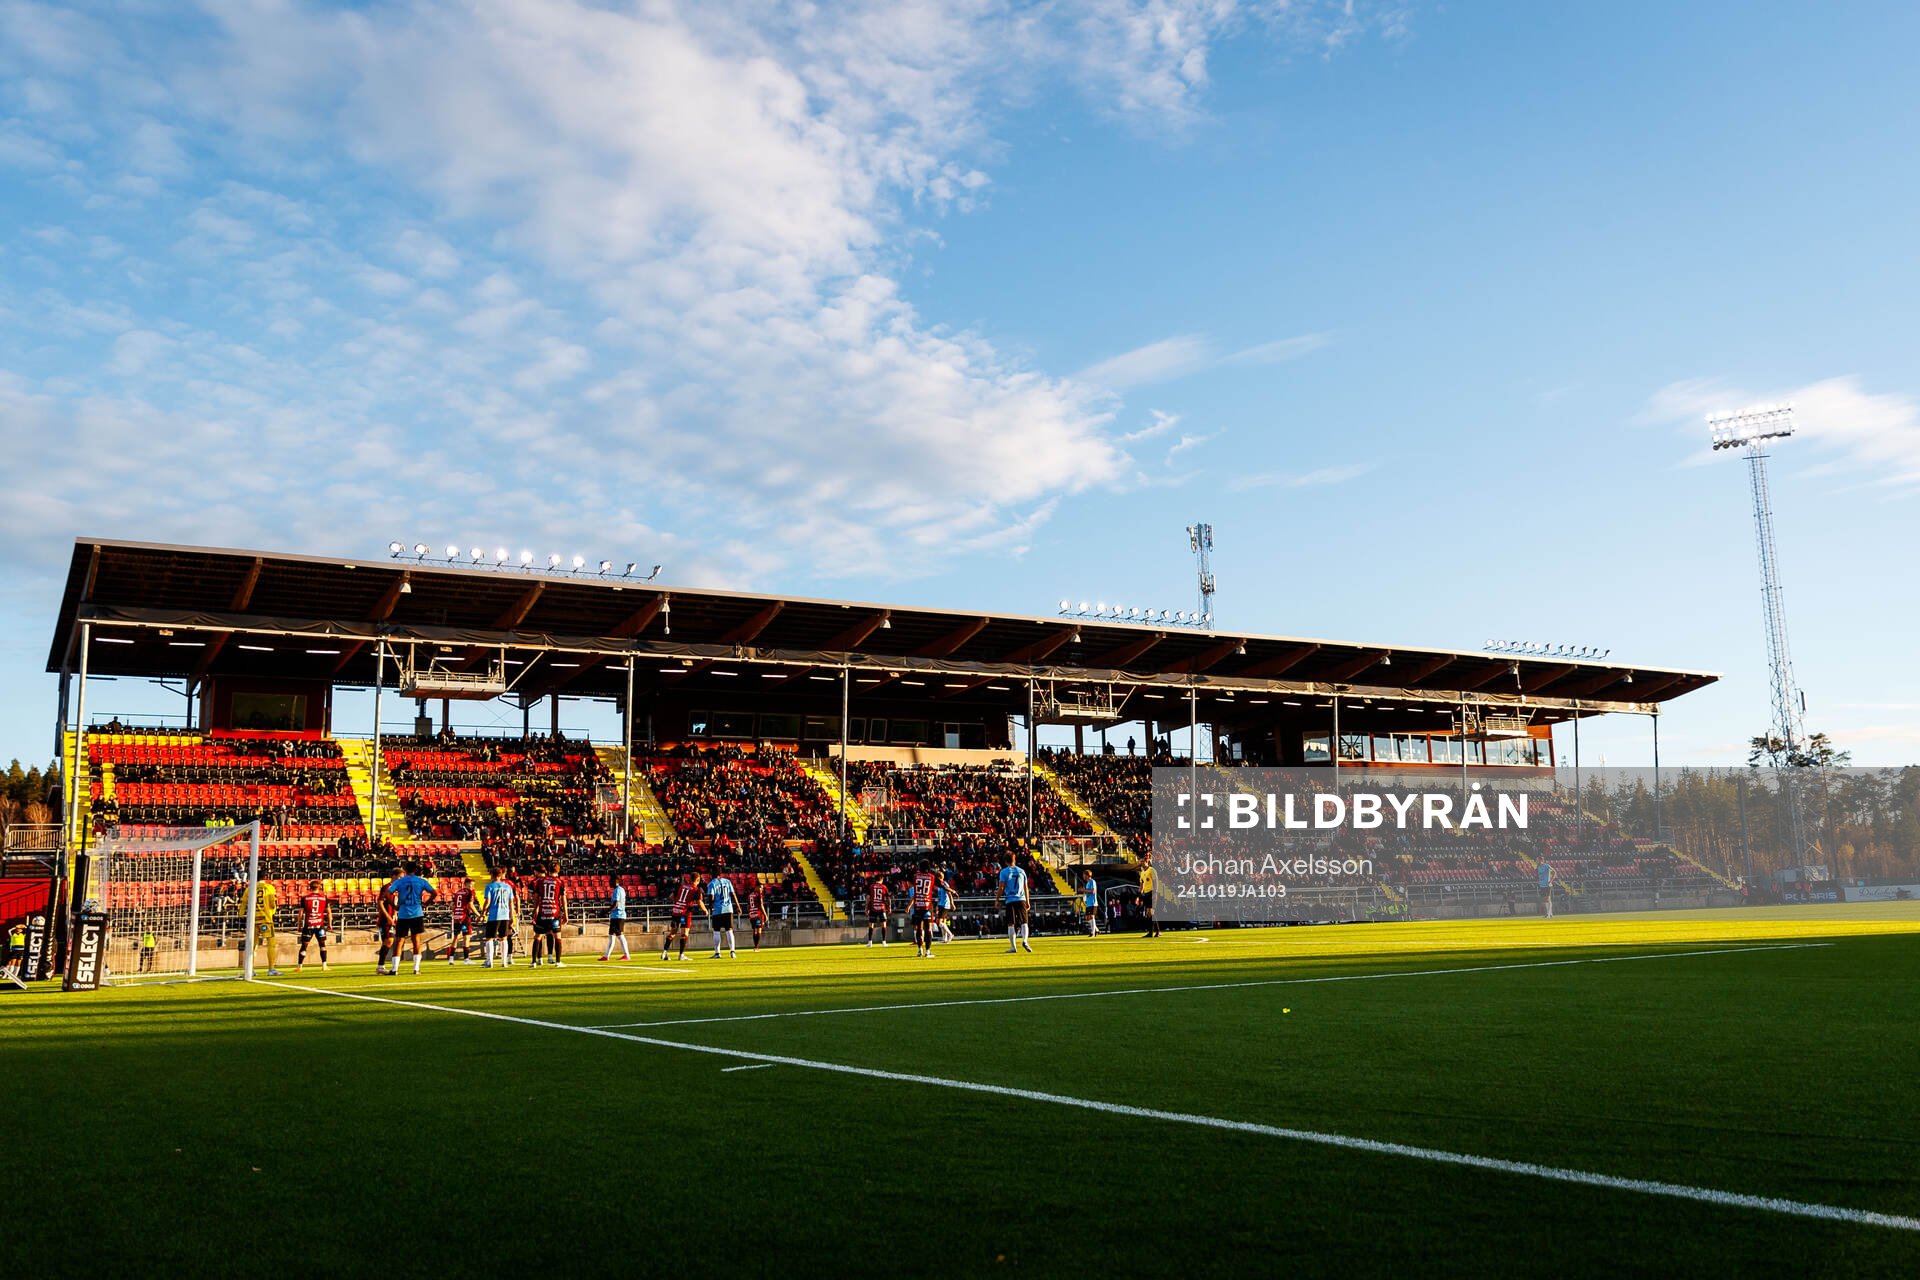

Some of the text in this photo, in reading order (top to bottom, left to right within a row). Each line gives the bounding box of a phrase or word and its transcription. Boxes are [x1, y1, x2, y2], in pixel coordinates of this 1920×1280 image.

[543, 884, 556, 899] 16
[873, 888, 883, 900] 15
[915, 879, 931, 895] 28
[456, 895, 463, 907] 6
[679, 888, 689, 902] 11
[312, 899, 320, 913] 9
[27, 931, 44, 974] SELECT
[77, 924, 100, 982] SELECT
